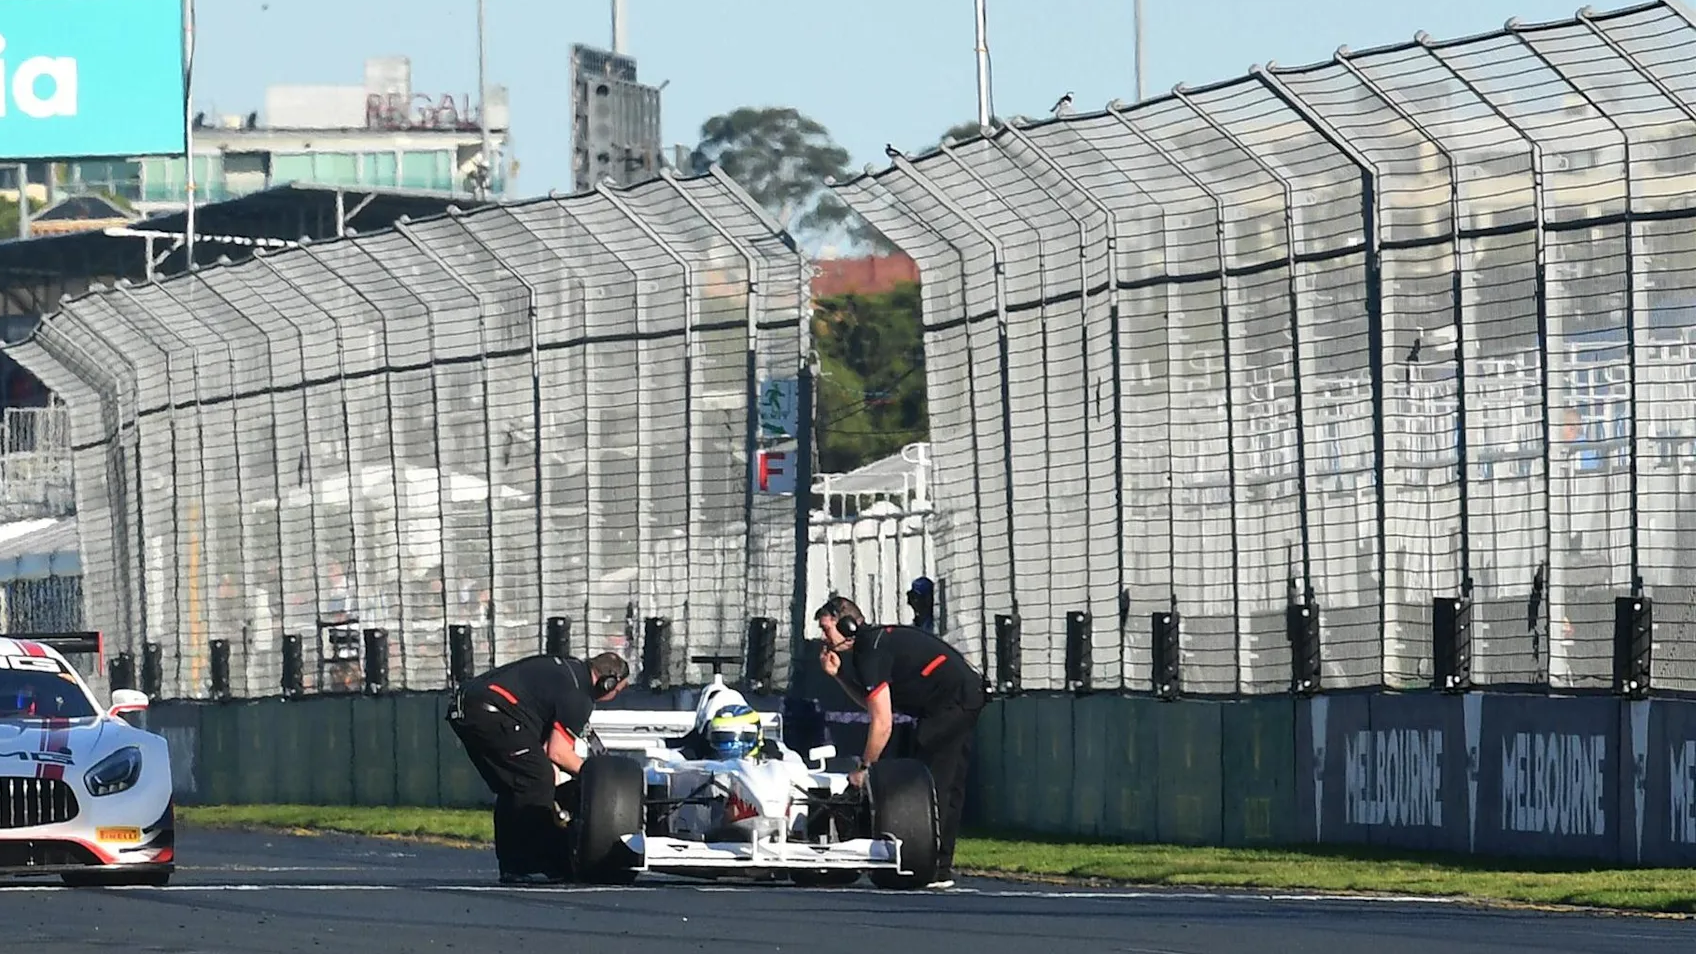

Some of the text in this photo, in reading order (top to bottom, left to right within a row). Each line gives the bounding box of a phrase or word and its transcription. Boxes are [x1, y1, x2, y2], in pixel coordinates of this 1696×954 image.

[366, 93, 481, 128] REGAL
[760, 452, 785, 491] F
[1345, 728, 1443, 827] MELBOURNE
[1502, 733, 1606, 836] MELBOURNE
